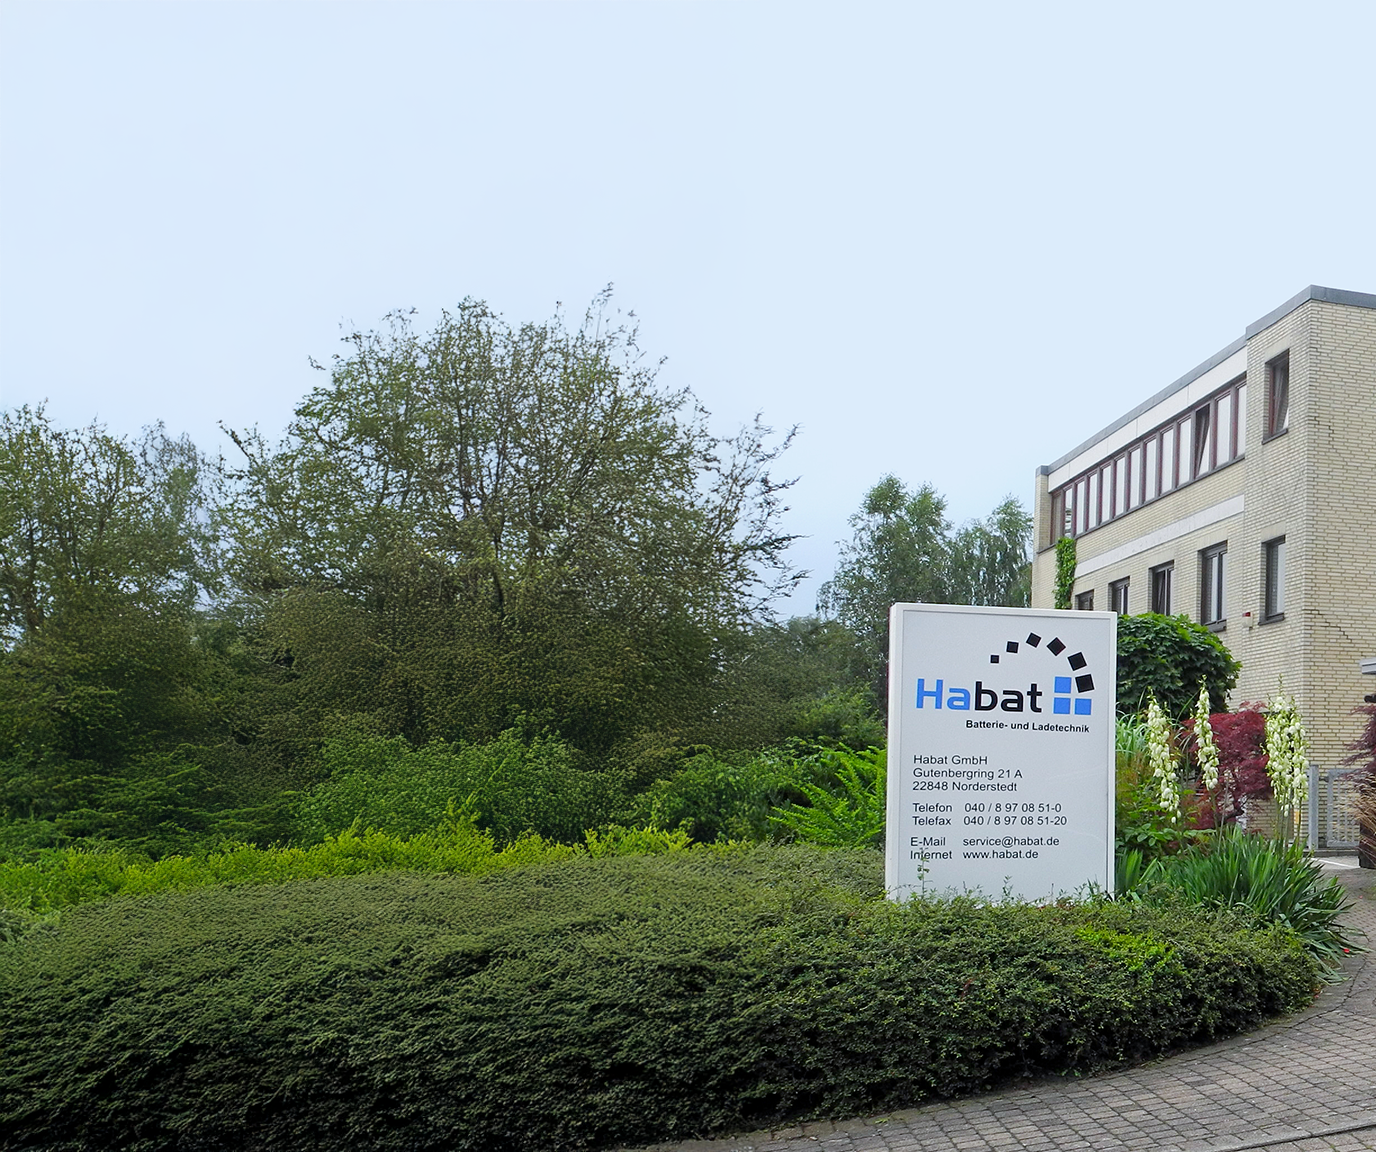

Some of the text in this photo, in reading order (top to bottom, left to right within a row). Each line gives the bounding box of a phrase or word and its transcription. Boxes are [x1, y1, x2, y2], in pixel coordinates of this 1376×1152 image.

[916, 678, 1043, 713] Habat
[965, 719, 1090, 733] Batterie- und Ladetechnik
[913, 754, 988, 766] Habat GmbH
[912, 767, 1023, 781] Gutenbergring 21 A
[912, 780, 1018, 792] 22848 Norderstedt
[912, 802, 953, 813] Telefon
[964, 802, 986, 813] 040
[994, 802, 1002, 813] 8
[1004, 802, 1019, 813] 97
[1021, 802, 1035, 813] 08
[1037, 802, 1062, 813] 51-0
[911, 815, 952, 826] Telefax
[963, 815, 985, 826] 040
[993, 815, 1001, 826] 8
[1003, 815, 1018, 826] 97
[1020, 815, 1034, 826] 08
[1037, 815, 1068, 826] 51-20
[910, 835, 1060, 849] E-Mail service@habat.de
[910, 849, 1039, 860] Internet www.habat.de
